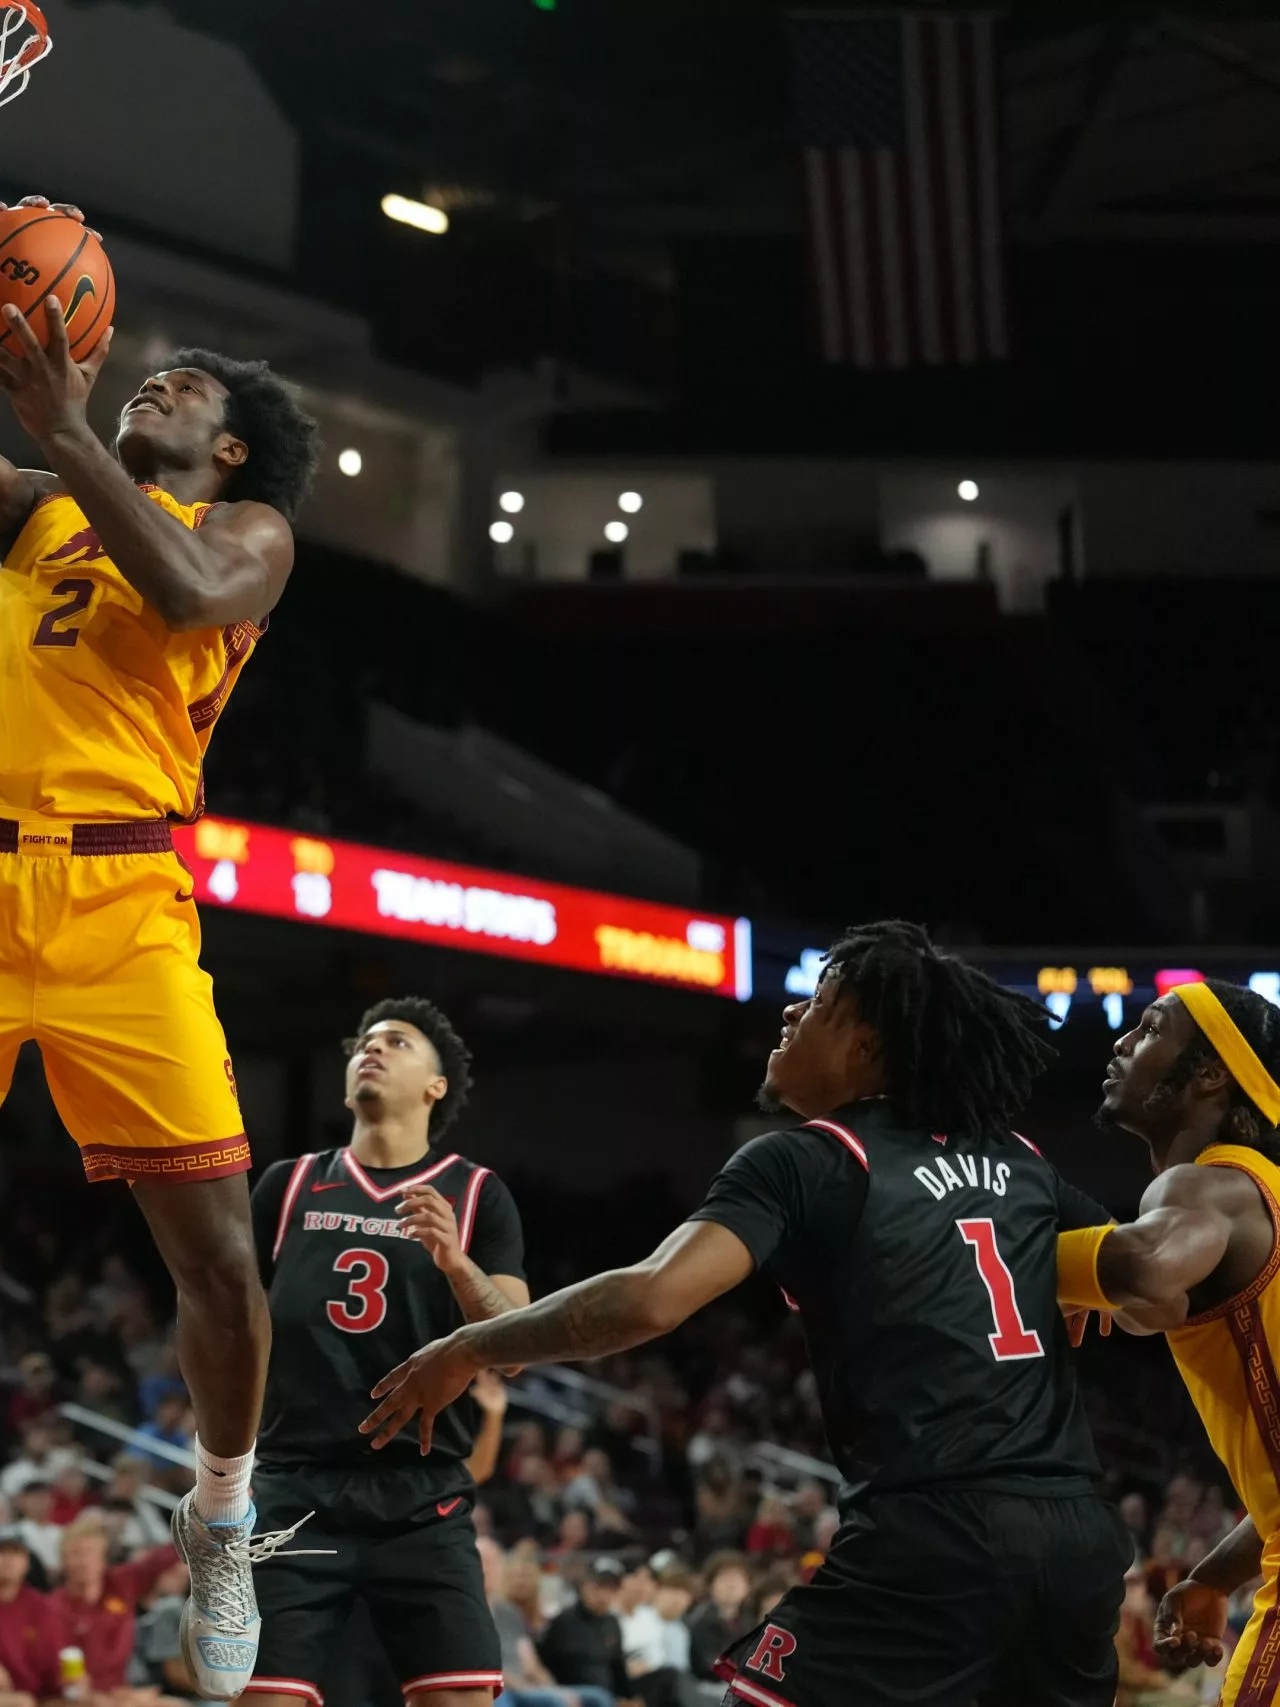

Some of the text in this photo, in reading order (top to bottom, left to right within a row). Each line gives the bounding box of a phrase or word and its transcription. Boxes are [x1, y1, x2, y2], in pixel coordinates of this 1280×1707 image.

[32, 578, 96, 649] 2
[23, 835, 68, 845] FIGHT ON
[207, 858, 239, 903] 4
[913, 1153, 1011, 1201] DAVIS
[303, 1211, 422, 1242] RUTGE
[326, 1248, 389, 1334] 3
[955, 1218, 1045, 1361] 1
[745, 1623, 797, 1682] R
